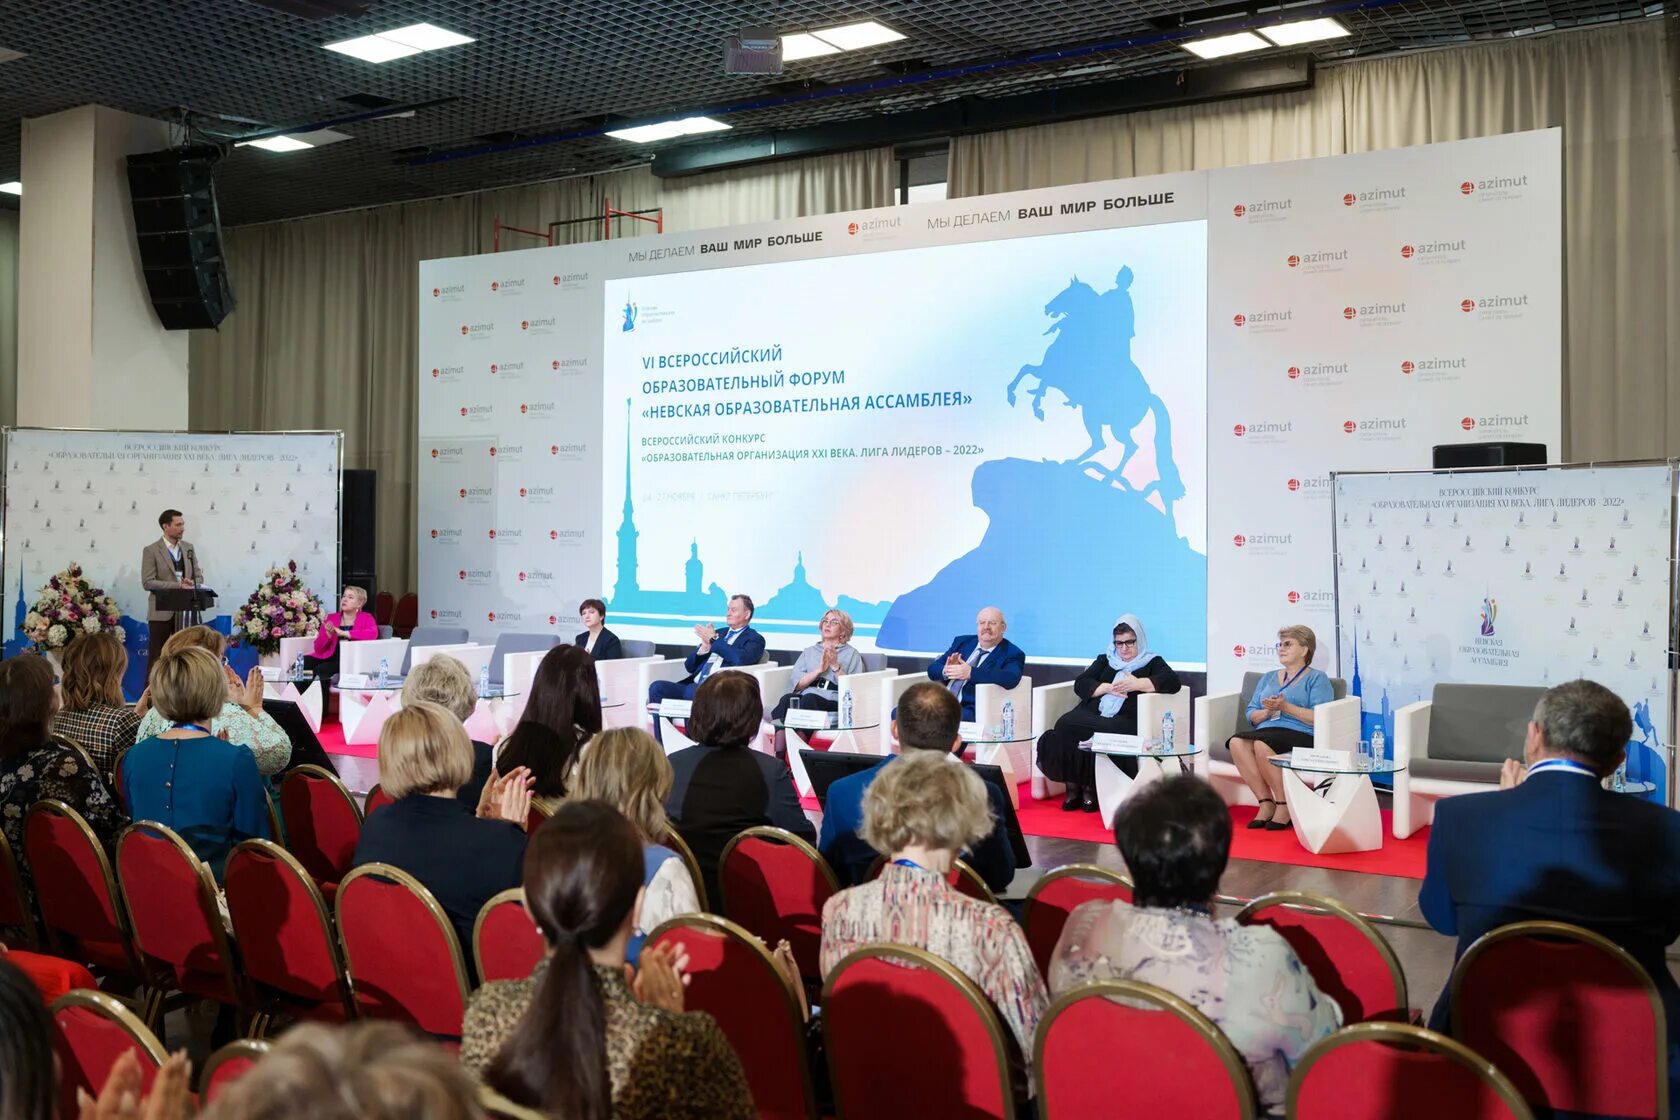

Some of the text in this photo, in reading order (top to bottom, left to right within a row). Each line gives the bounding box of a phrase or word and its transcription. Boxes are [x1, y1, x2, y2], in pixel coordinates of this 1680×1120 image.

[1478, 175, 1528, 190] azimut
[1359, 187, 1406, 202] azimut
[927, 191, 1175, 230] МЫ ДЕЛАЕМ ВАШ МИР БОЛЬШЕ
[1249, 199, 1292, 213] azimut
[861, 216, 902, 231] azimut
[628, 231, 823, 263] МЫ ДЕЛАЕМ ВАШ МИР БОЛЬШЕ
[1418, 240, 1466, 254] azimut
[1303, 249, 1348, 263] azimut
[562, 272, 588, 282] azimut
[500, 279, 525, 287] azimut
[441, 285, 465, 295] azimut
[1479, 294, 1528, 308] azimut
[1359, 302, 1407, 316] azimut
[1249, 309, 1292, 322] azimut
[470, 323, 494, 331] azimut
[530, 318, 556, 327] azimut
[642, 343, 783, 369] VI ВСЕРОССИЙСКИЙ
[500, 362, 524, 371] azimut
[561, 358, 587, 367] azimut
[1418, 357, 1467, 370] azimut
[440, 366, 464, 375] azimut
[1303, 362, 1349, 375] azimut
[642, 369, 845, 394] ОБРАЗОВАТЕЛЬНЫЙ ФОРУМ
[469, 405, 493, 413] azimut
[529, 402, 555, 411] azimut
[642, 391, 973, 419] «НЕВСКАЯ ОБРАЗОВАТЕЛЬНАЯ АССАМБЛЕЯ»
[1359, 418, 1407, 429] azimut
[1479, 414, 1529, 426] azimut
[1249, 421, 1292, 433] azimut
[641, 433, 766, 446] ВСЕРОССИЙСКИЙ КОНКУРС
[498, 446, 523, 454] azimut
[560, 444, 586, 452] azimut
[641, 451, 734, 462] «ОБРАЗОВАТЕЛЬНАЯ
[737, 449, 809, 461] ОРГАНИЗАЦИЯ
[811, 449, 827, 459] XXI
[830, 448, 858, 459] ВЕКА.
[860, 447, 889, 458] ЛИГА
[890, 445, 943, 459] ЛИДЕРОВ
[953, 444, 985, 456] 2022»
[468, 487, 492, 496] azimut
[528, 487, 553, 495] azimut
[1439, 486, 1539, 497] ВСЕРОССИЙСКИЙ КОНКУРС
[439, 529, 462, 537] azimut
[559, 530, 585, 538] azimut
[1249, 533, 1292, 544] azimut
[468, 570, 492, 578] azimut
[527, 571, 553, 580] azimut
[439, 610, 462, 618] azimut
[497, 613, 521, 621] azimut
[558, 615, 581, 623] azimu
[1474, 637, 1503, 647] НЕВСКАЯ
